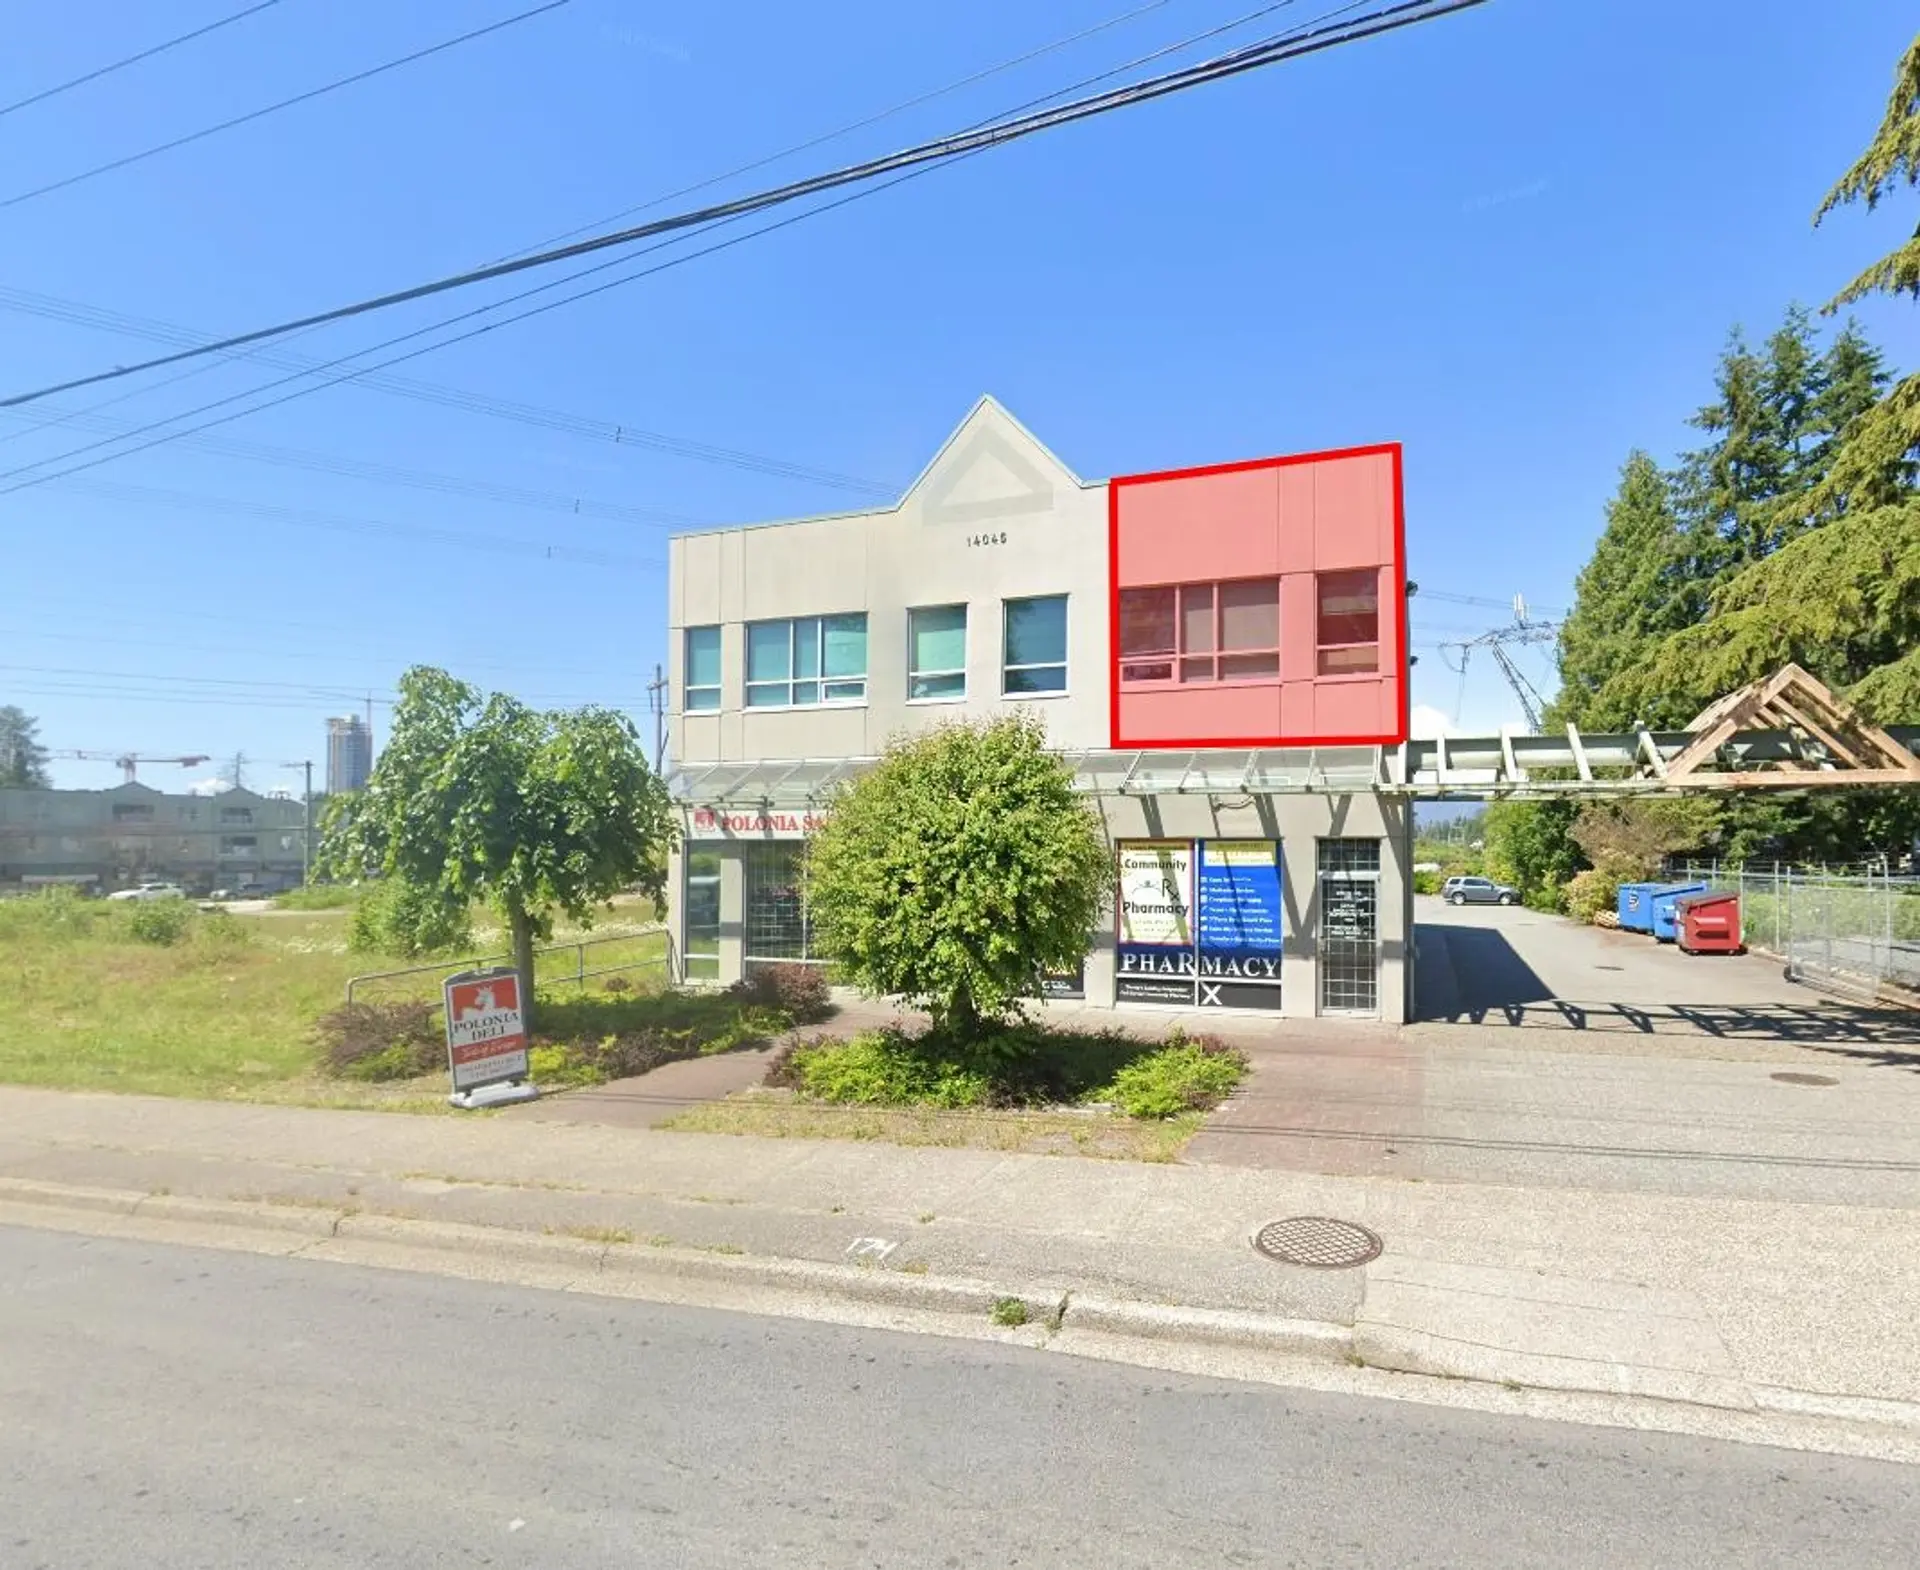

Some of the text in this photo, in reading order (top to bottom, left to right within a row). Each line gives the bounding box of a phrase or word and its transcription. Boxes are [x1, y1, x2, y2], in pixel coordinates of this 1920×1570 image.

[721, 815, 798, 831] POLONIA
[1124, 859, 1187, 871] Community
[1122, 901, 1189, 917] Pharmacy
[1121, 952, 1279, 978] PHARMACY
[454, 1012, 519, 1033] POLONIA
[472, 1025, 505, 1041] DELI
